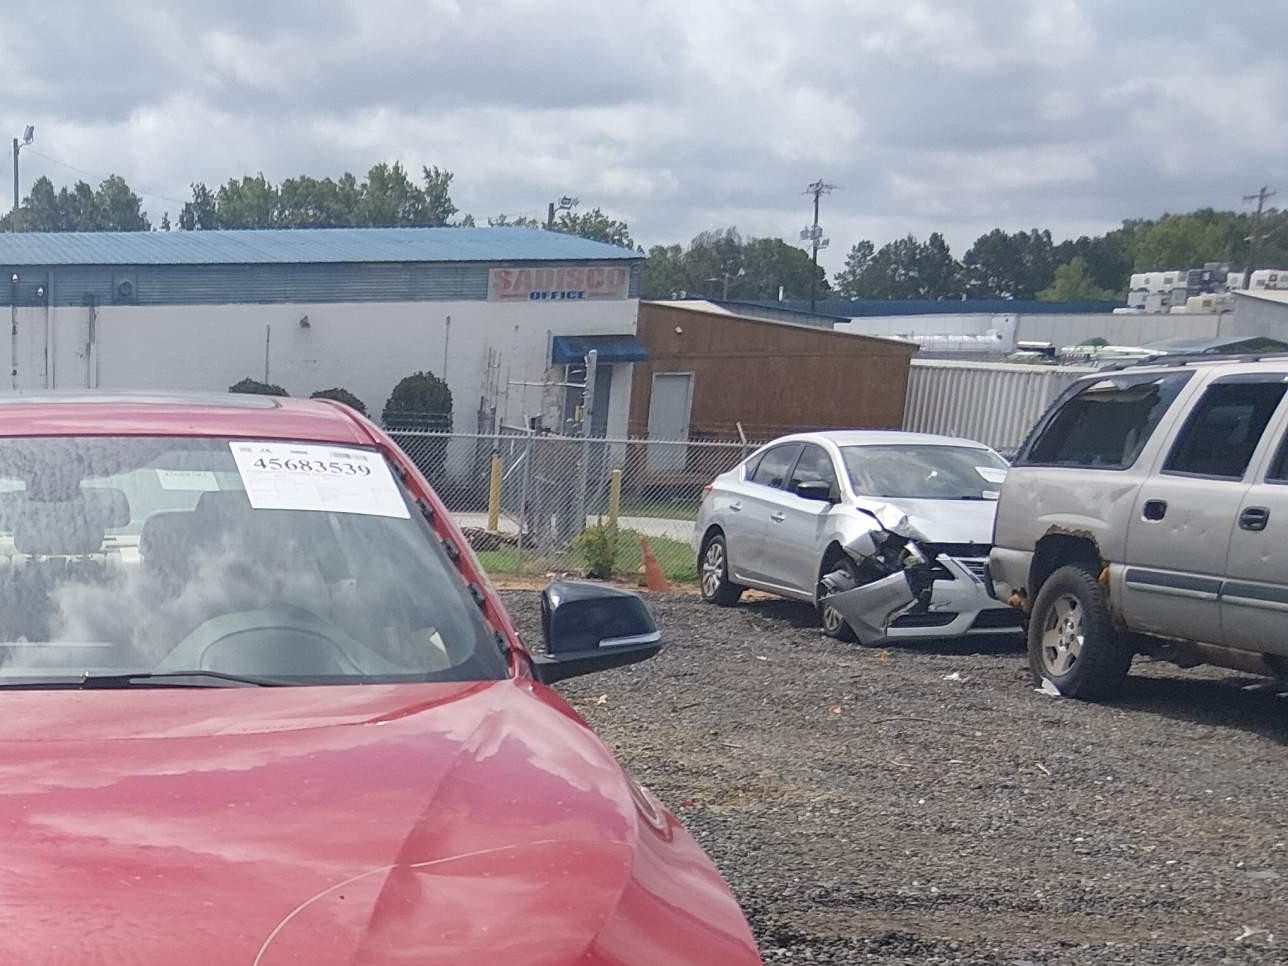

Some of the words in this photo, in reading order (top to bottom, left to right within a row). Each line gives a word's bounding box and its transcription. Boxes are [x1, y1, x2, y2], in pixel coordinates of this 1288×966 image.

[494, 267, 626, 290] SADISCO
[530, 291, 585, 300] OFFICE
[254, 457, 371, 477] 45683539
